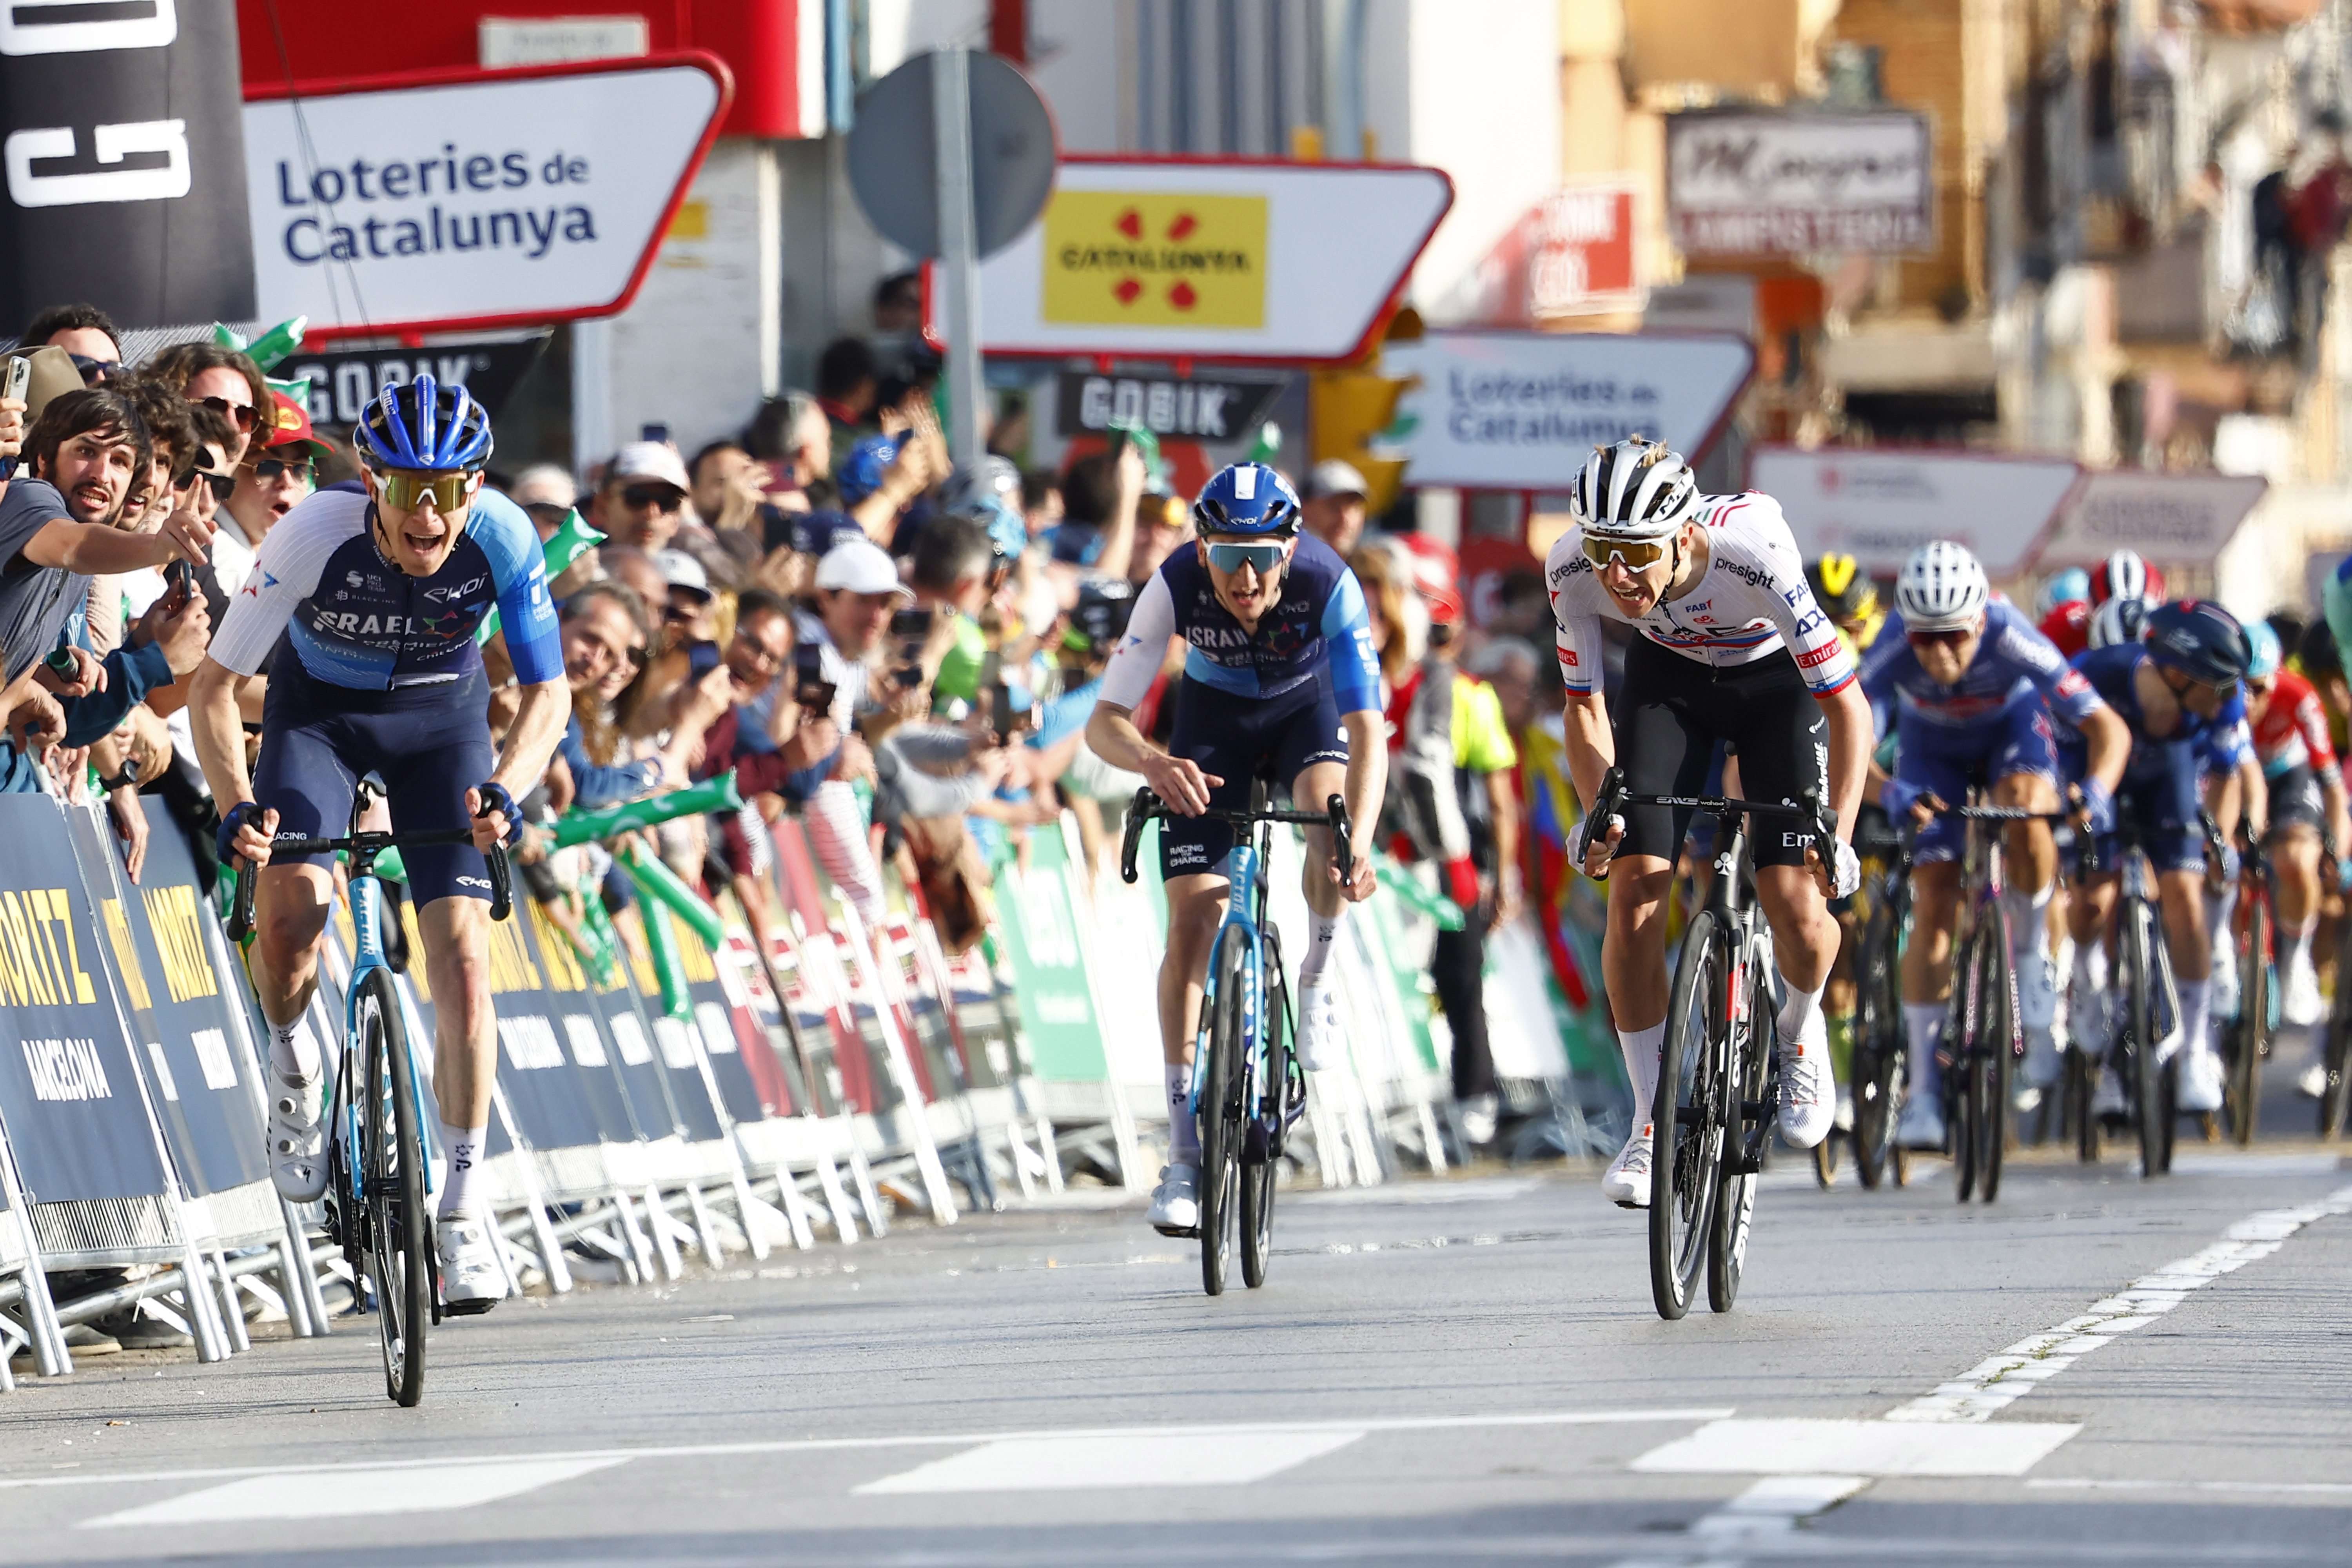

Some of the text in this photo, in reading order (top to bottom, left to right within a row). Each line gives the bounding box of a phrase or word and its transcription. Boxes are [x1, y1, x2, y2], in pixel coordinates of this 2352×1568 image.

[278, 143, 590, 206] Loteries de
[285, 205, 598, 264] Catalunya
[1060, 245, 1249, 274] CATALUNYA
[1080, 374, 1229, 437] GOBIK
[367, 573, 381, 582] UCI
[1715, 557, 1775, 590] presight
[273, 832, 307, 841] ACING
[1169, 844, 1204, 855] RACING
[1170, 856, 1208, 867] CHANGE
[1232, 853, 1247, 914] FACTOR
[358, 885, 377, 956] FACTOR
[21, 1038, 113, 1102] BARCELONA
